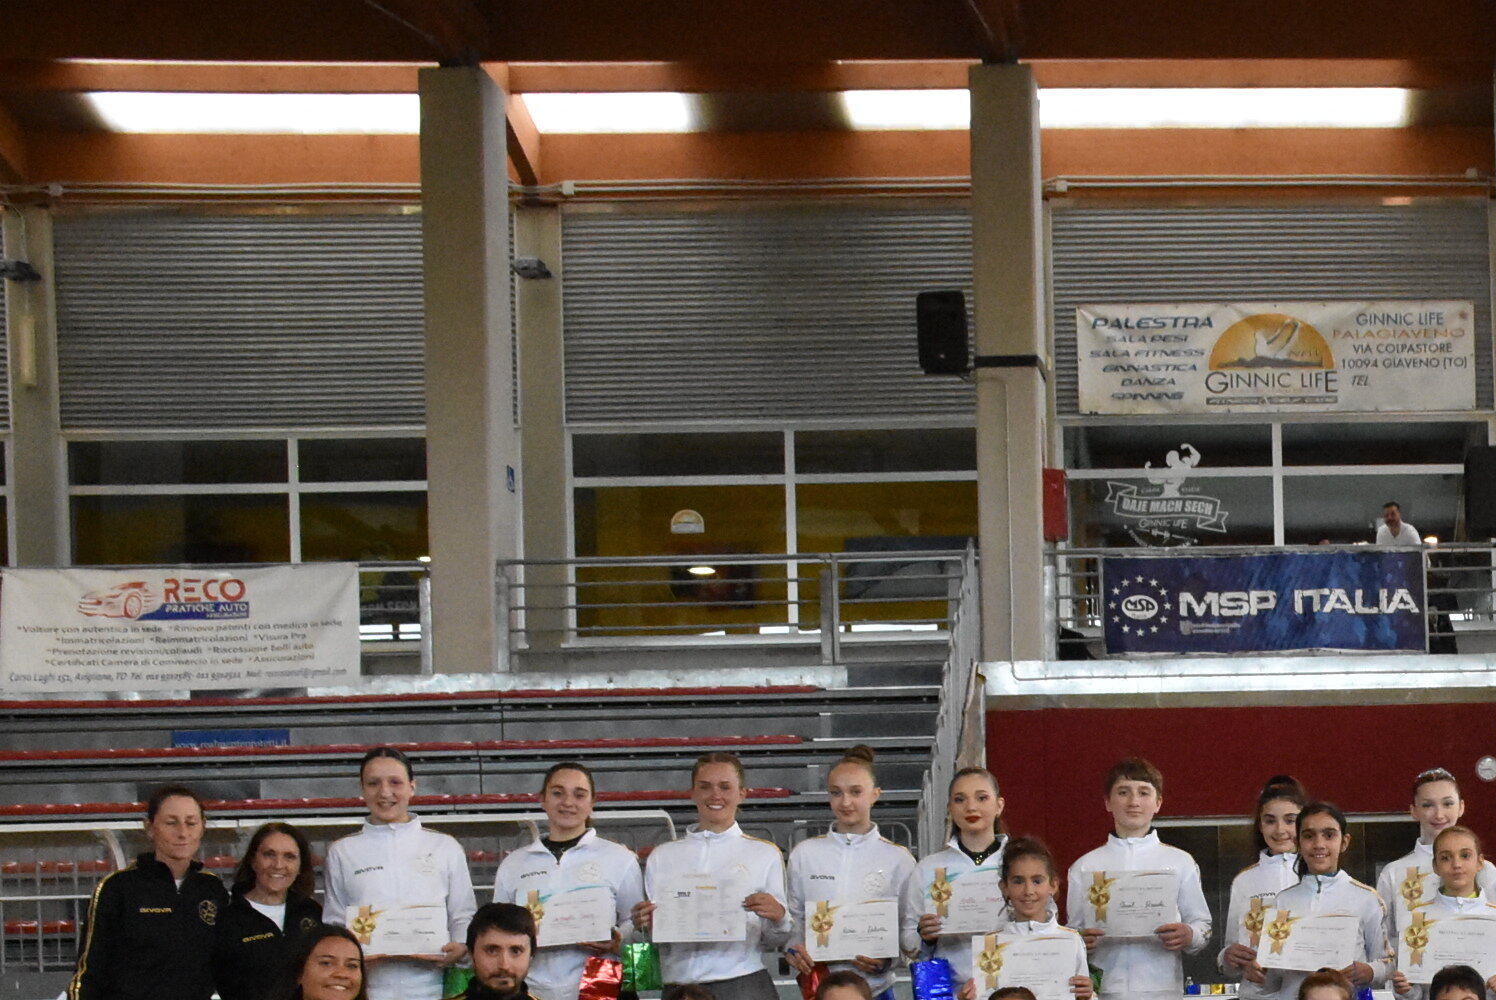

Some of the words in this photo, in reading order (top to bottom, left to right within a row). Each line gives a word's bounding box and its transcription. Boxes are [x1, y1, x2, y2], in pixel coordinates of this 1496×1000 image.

[1091, 316, 1213, 329] PALESTRA
[1356, 312, 1414, 326] GINNIC
[1418, 312, 1444, 325] LIFE
[1134, 348, 1206, 357] FITNESS
[1353, 344, 1373, 354] VIA
[1376, 342, 1453, 353] COLPASTORE
[1102, 363, 1198, 373] GINNASTICA
[1341, 358, 1379, 369] 10094
[1382, 357, 1440, 369] GIAVENO
[1443, 356, 1468, 369] (TO)
[1121, 378, 1176, 387] DANZA
[1205, 371, 1291, 394] GINNIC
[1301, 370, 1338, 392] LIFE
[1149, 499, 1183, 513] MACH
[1184, 499, 1214, 516] SECH
[164, 578, 246, 602] RECO
[165, 603, 215, 613] PRATICHE
[219, 603, 248, 613] AUTO
[1179, 590, 1277, 617] MSP
[1293, 588, 1420, 615] ITALIA
